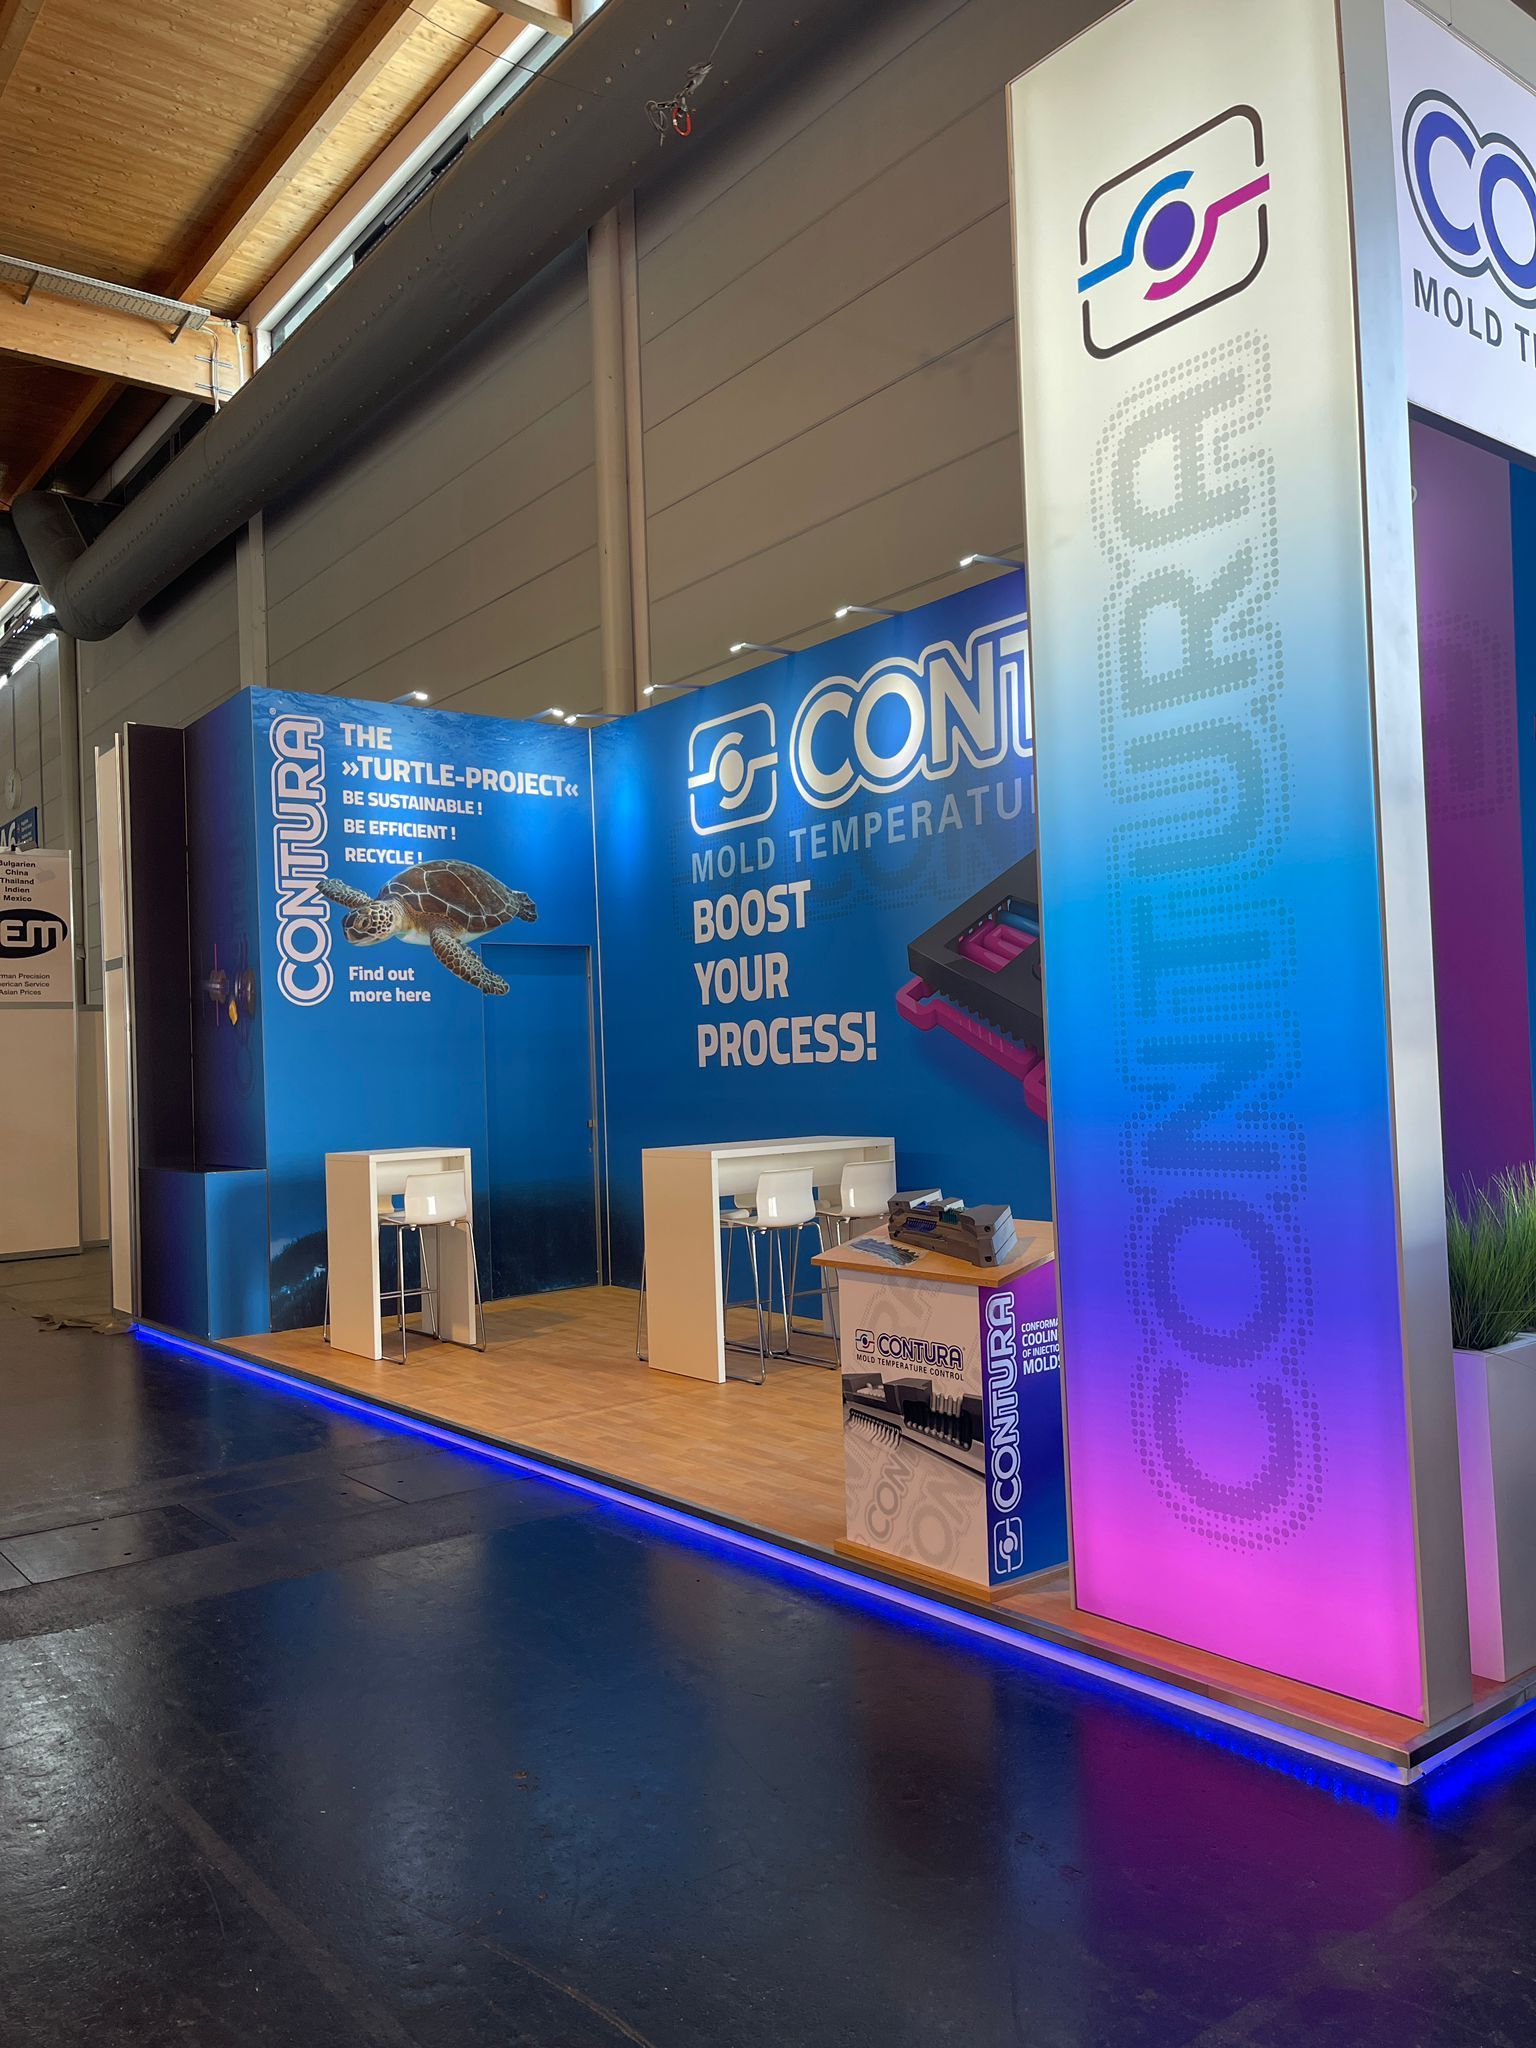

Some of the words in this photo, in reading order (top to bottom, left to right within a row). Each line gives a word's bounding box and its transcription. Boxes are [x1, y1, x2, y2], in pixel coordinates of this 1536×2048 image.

[1412, 267, 1503, 347] MOLD
[340, 722, 393, 750] THE
[343, 790, 365, 806] BE
[367, 791, 475, 815] SUSTAINABLE
[344, 818, 366, 834] BE
[369, 820, 448, 840] EFFICIENT
[269, 714, 334, 1007] CONTURA
[345, 847, 414, 865] RECYCLE
[691, 836, 776, 884] MOLD
[0, 877, 35, 885] Thailand
[3, 894, 32, 902] Mexico
[693, 880, 811, 944] BOOST
[1091, 329, 1328, 1553] CONTURA
[349, 966, 384, 981] Find
[387, 967, 415, 981] out
[694, 952, 789, 1005] YOUR
[350, 990, 392, 1002] more
[396, 988, 431, 1002] here
[697, 1011, 877, 1068] PROCESS!
[877, 1333, 964, 1371] CONTURA
[1022, 1348, 1032, 1358] OF
[856, 1353, 876, 1364] MOLD
[877, 1357, 928, 1374] TEMPERATURE
[929, 1367, 964, 1381] CONTROL
[985, 1291, 1022, 1513] CONTURA
